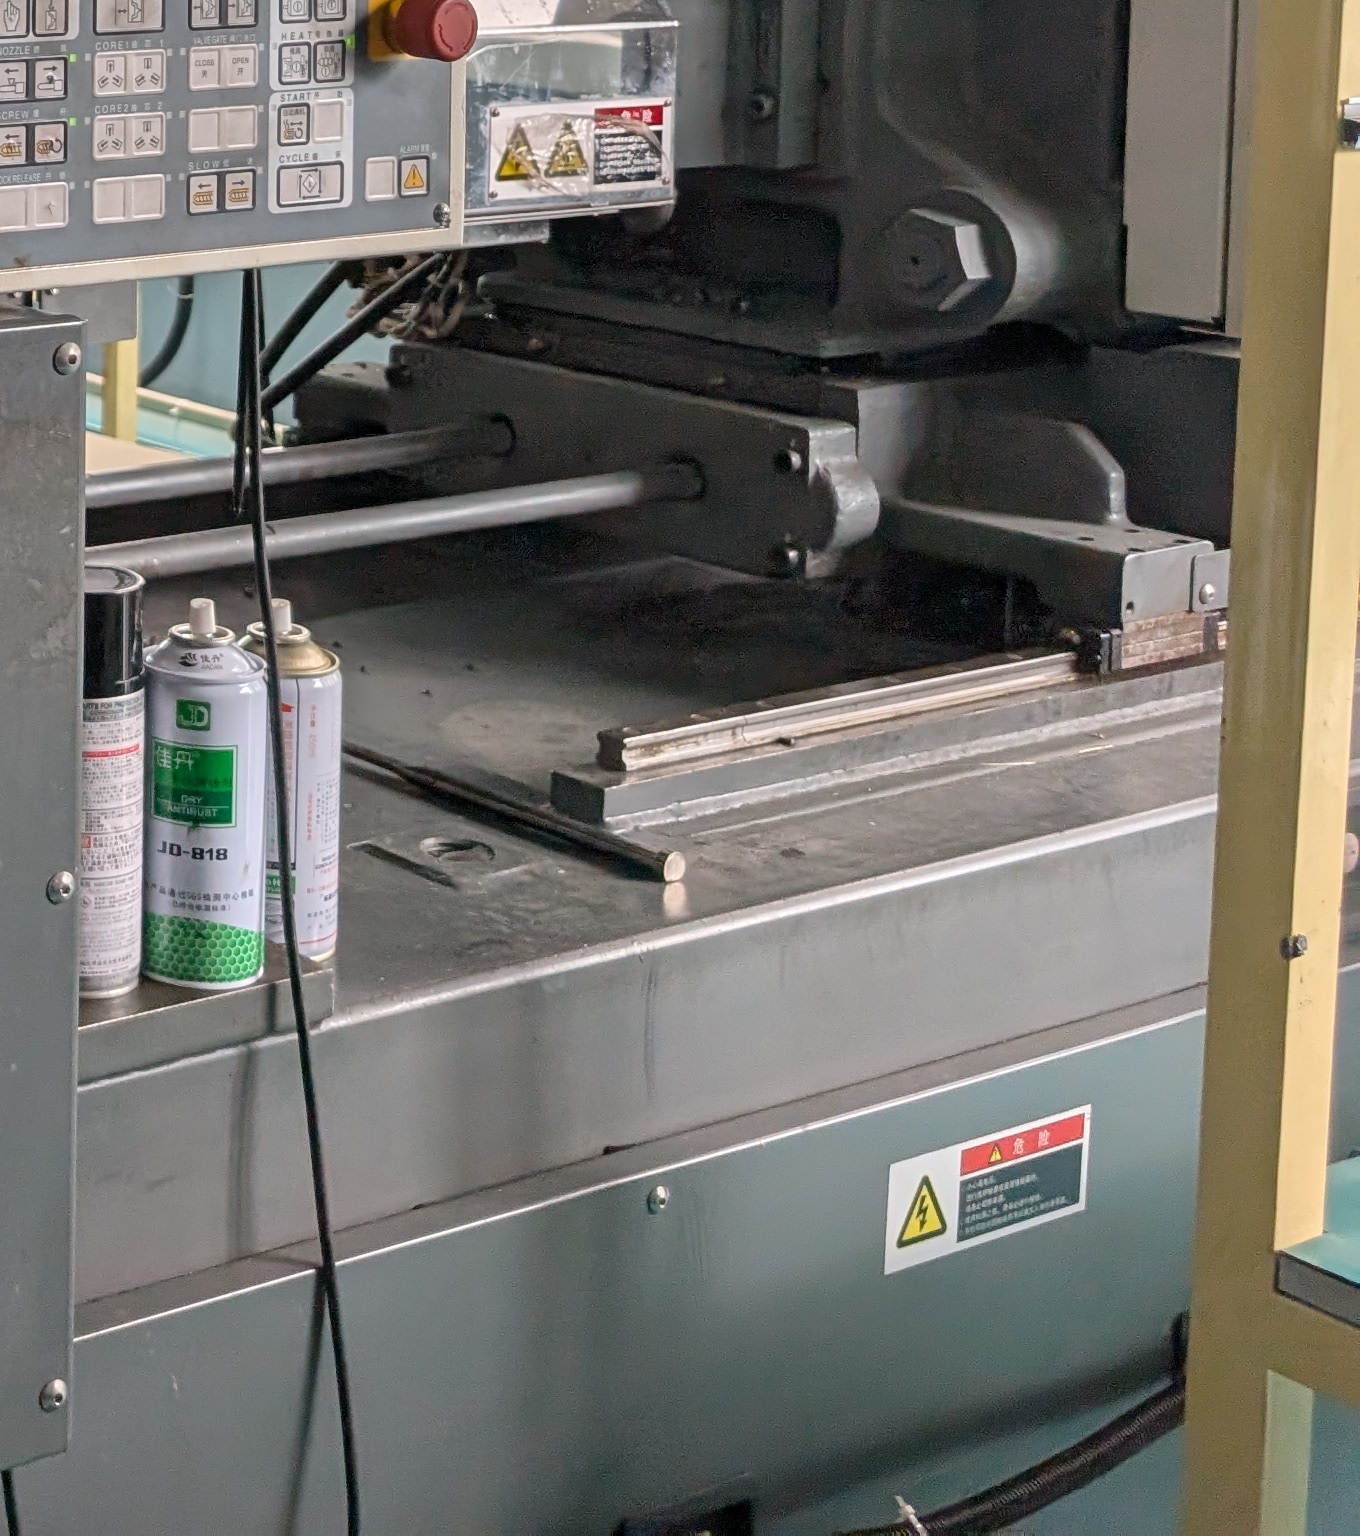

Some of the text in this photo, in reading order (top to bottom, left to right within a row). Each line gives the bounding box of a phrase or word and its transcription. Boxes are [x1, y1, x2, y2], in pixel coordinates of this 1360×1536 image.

[193, 35, 227, 45] VALVE GATE
[282, 31, 312, 40] HEAT
[194, 59, 215, 67] CLOSE
[231, 57, 249, 65] OPEN
[280, 92, 311, 102] START
[399, 144, 419, 153] ALARM
[279, 153, 309, 163] CYCLE
[188, 160, 219, 170] SLOW
[13, 173, 41, 183] RELEASE
[180, 704, 209, 727] JD
[156, 746, 194, 771] 佳丹
[157, 841, 228, 861] JD-818
[1013, 1129, 1051, 1155] 危险
